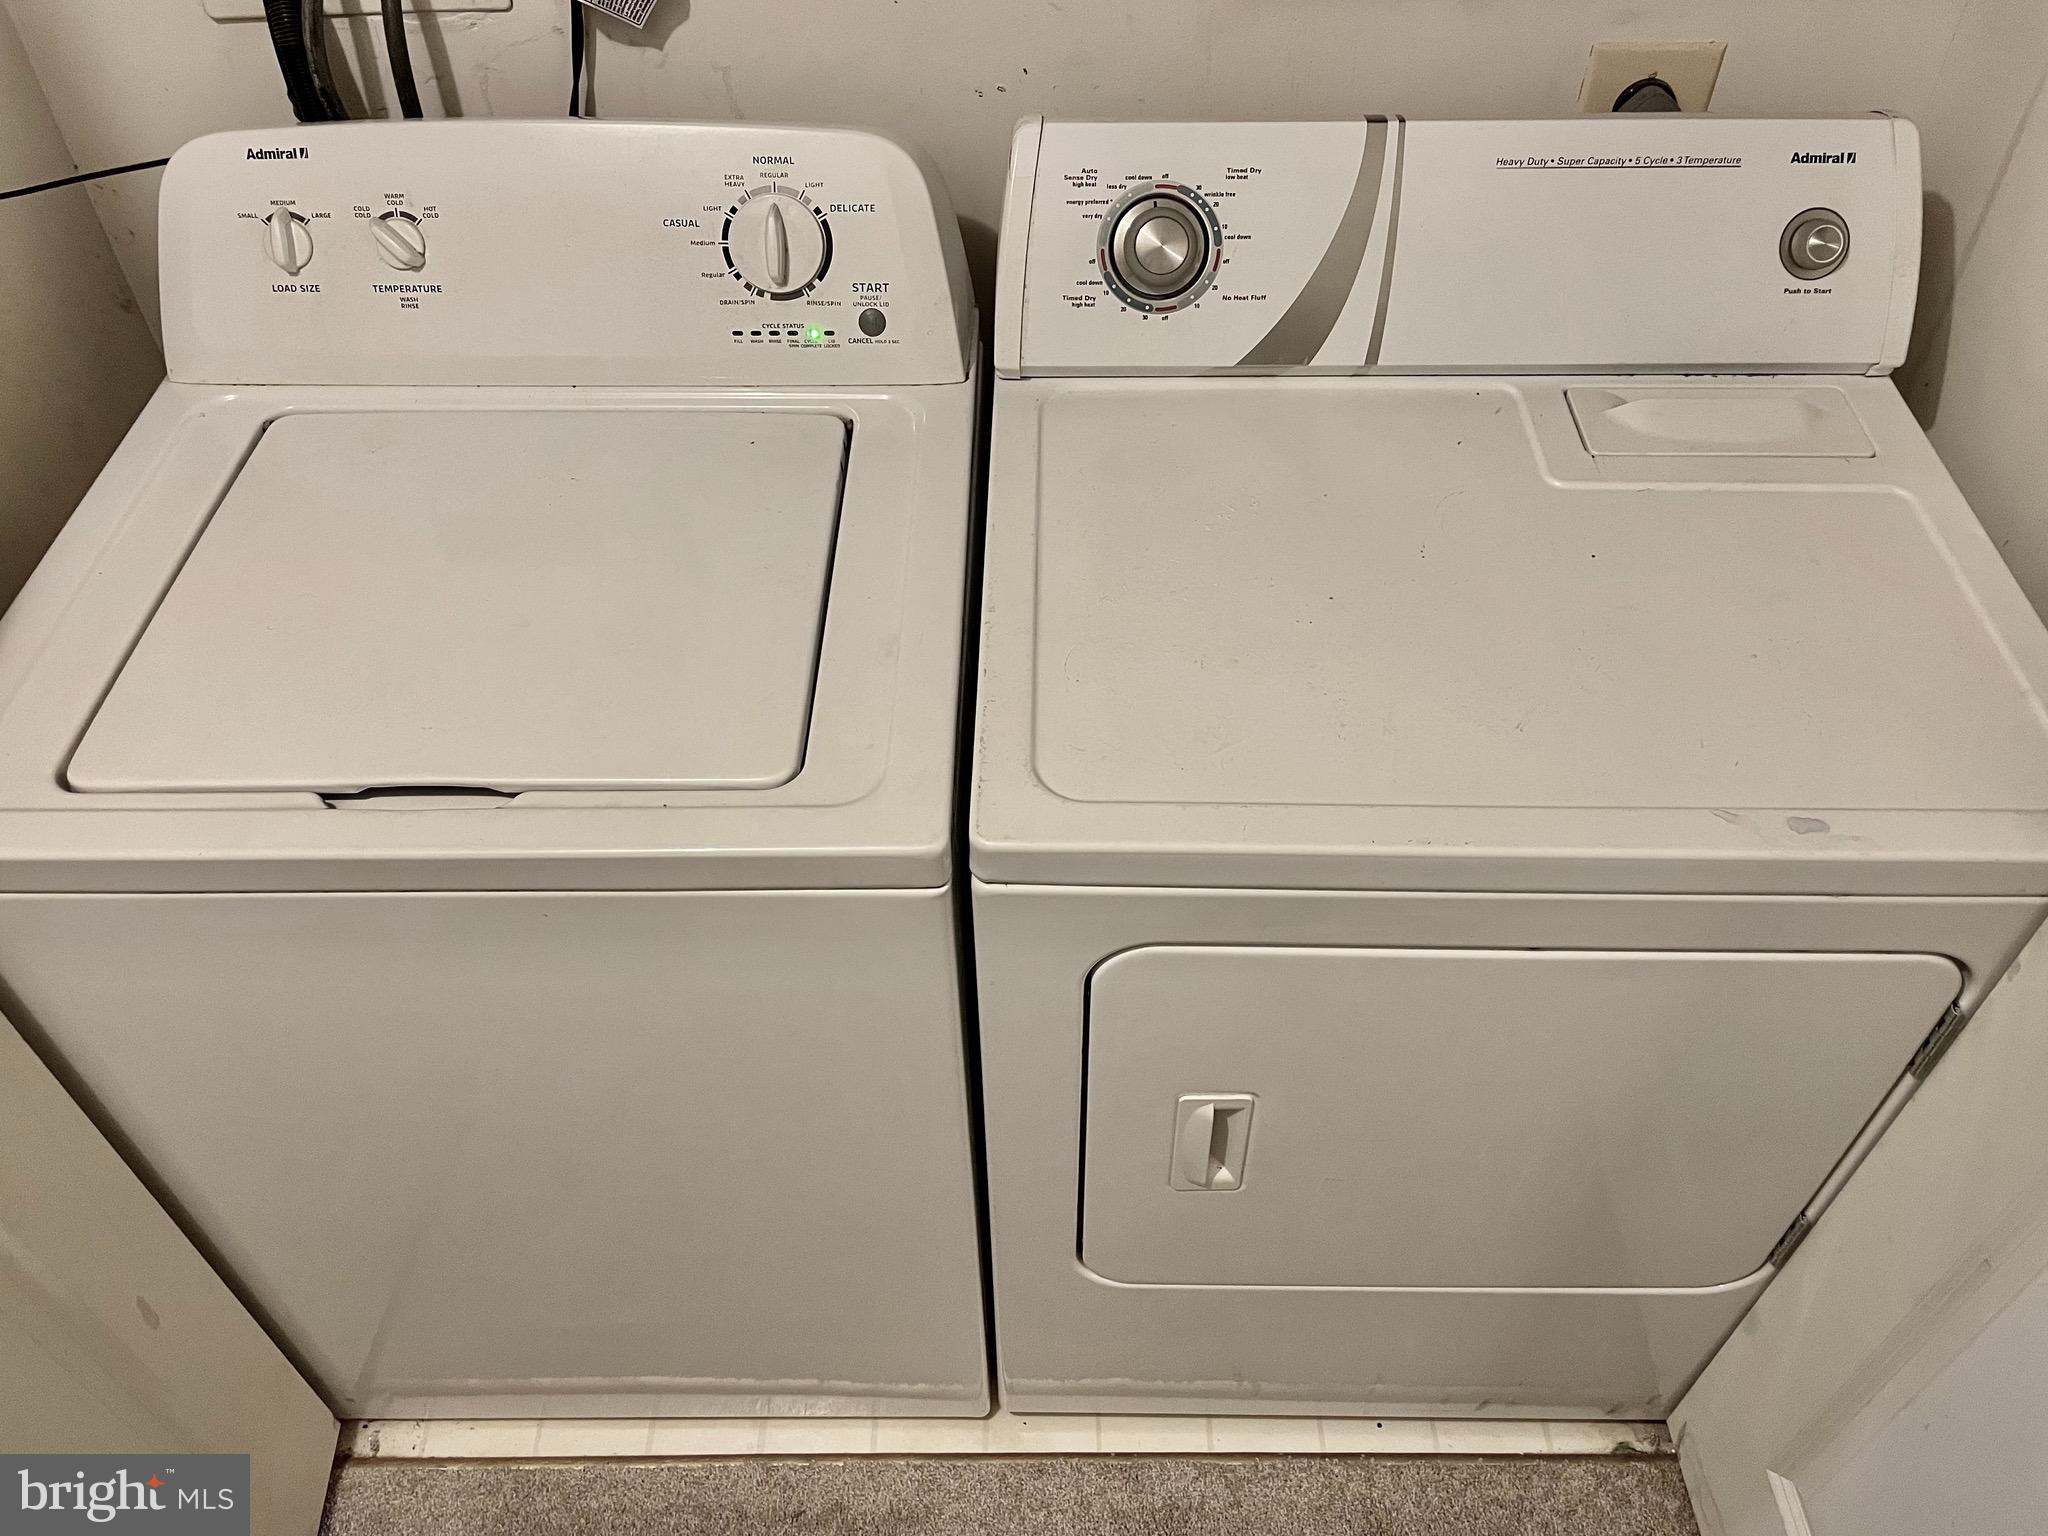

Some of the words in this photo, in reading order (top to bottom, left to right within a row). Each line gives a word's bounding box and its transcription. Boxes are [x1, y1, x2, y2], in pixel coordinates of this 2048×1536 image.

[246, 148, 298, 160] Admiral
[1791, 152, 1845, 164] Admiral
[752, 156, 795, 165] NORMAL
[1496, 157, 1525, 168] Heavy
[1527, 157, 1549, 168] Duty
[1557, 157, 1585, 168] Super
[1587, 157, 1627, 168] Capacity
[1635, 156, 1641, 165] 5
[1643, 156, 1669, 167] Cycle
[1676, 156, 1682, 165] 3
[1684, 156, 1742, 166] Temperature
[829, 204, 876, 213] DELICATE
[663, 219, 700, 228] CASUAL
[272, 285, 298, 293] LOAD
[300, 285, 321, 293] SIZE
[372, 285, 443, 293] TEMPERATURE
[852, 282, 890, 293] START
[1783, 287, 1802, 295] Push
[1803, 287, 1812, 295] to
[1813, 287, 1832, 295] Start
